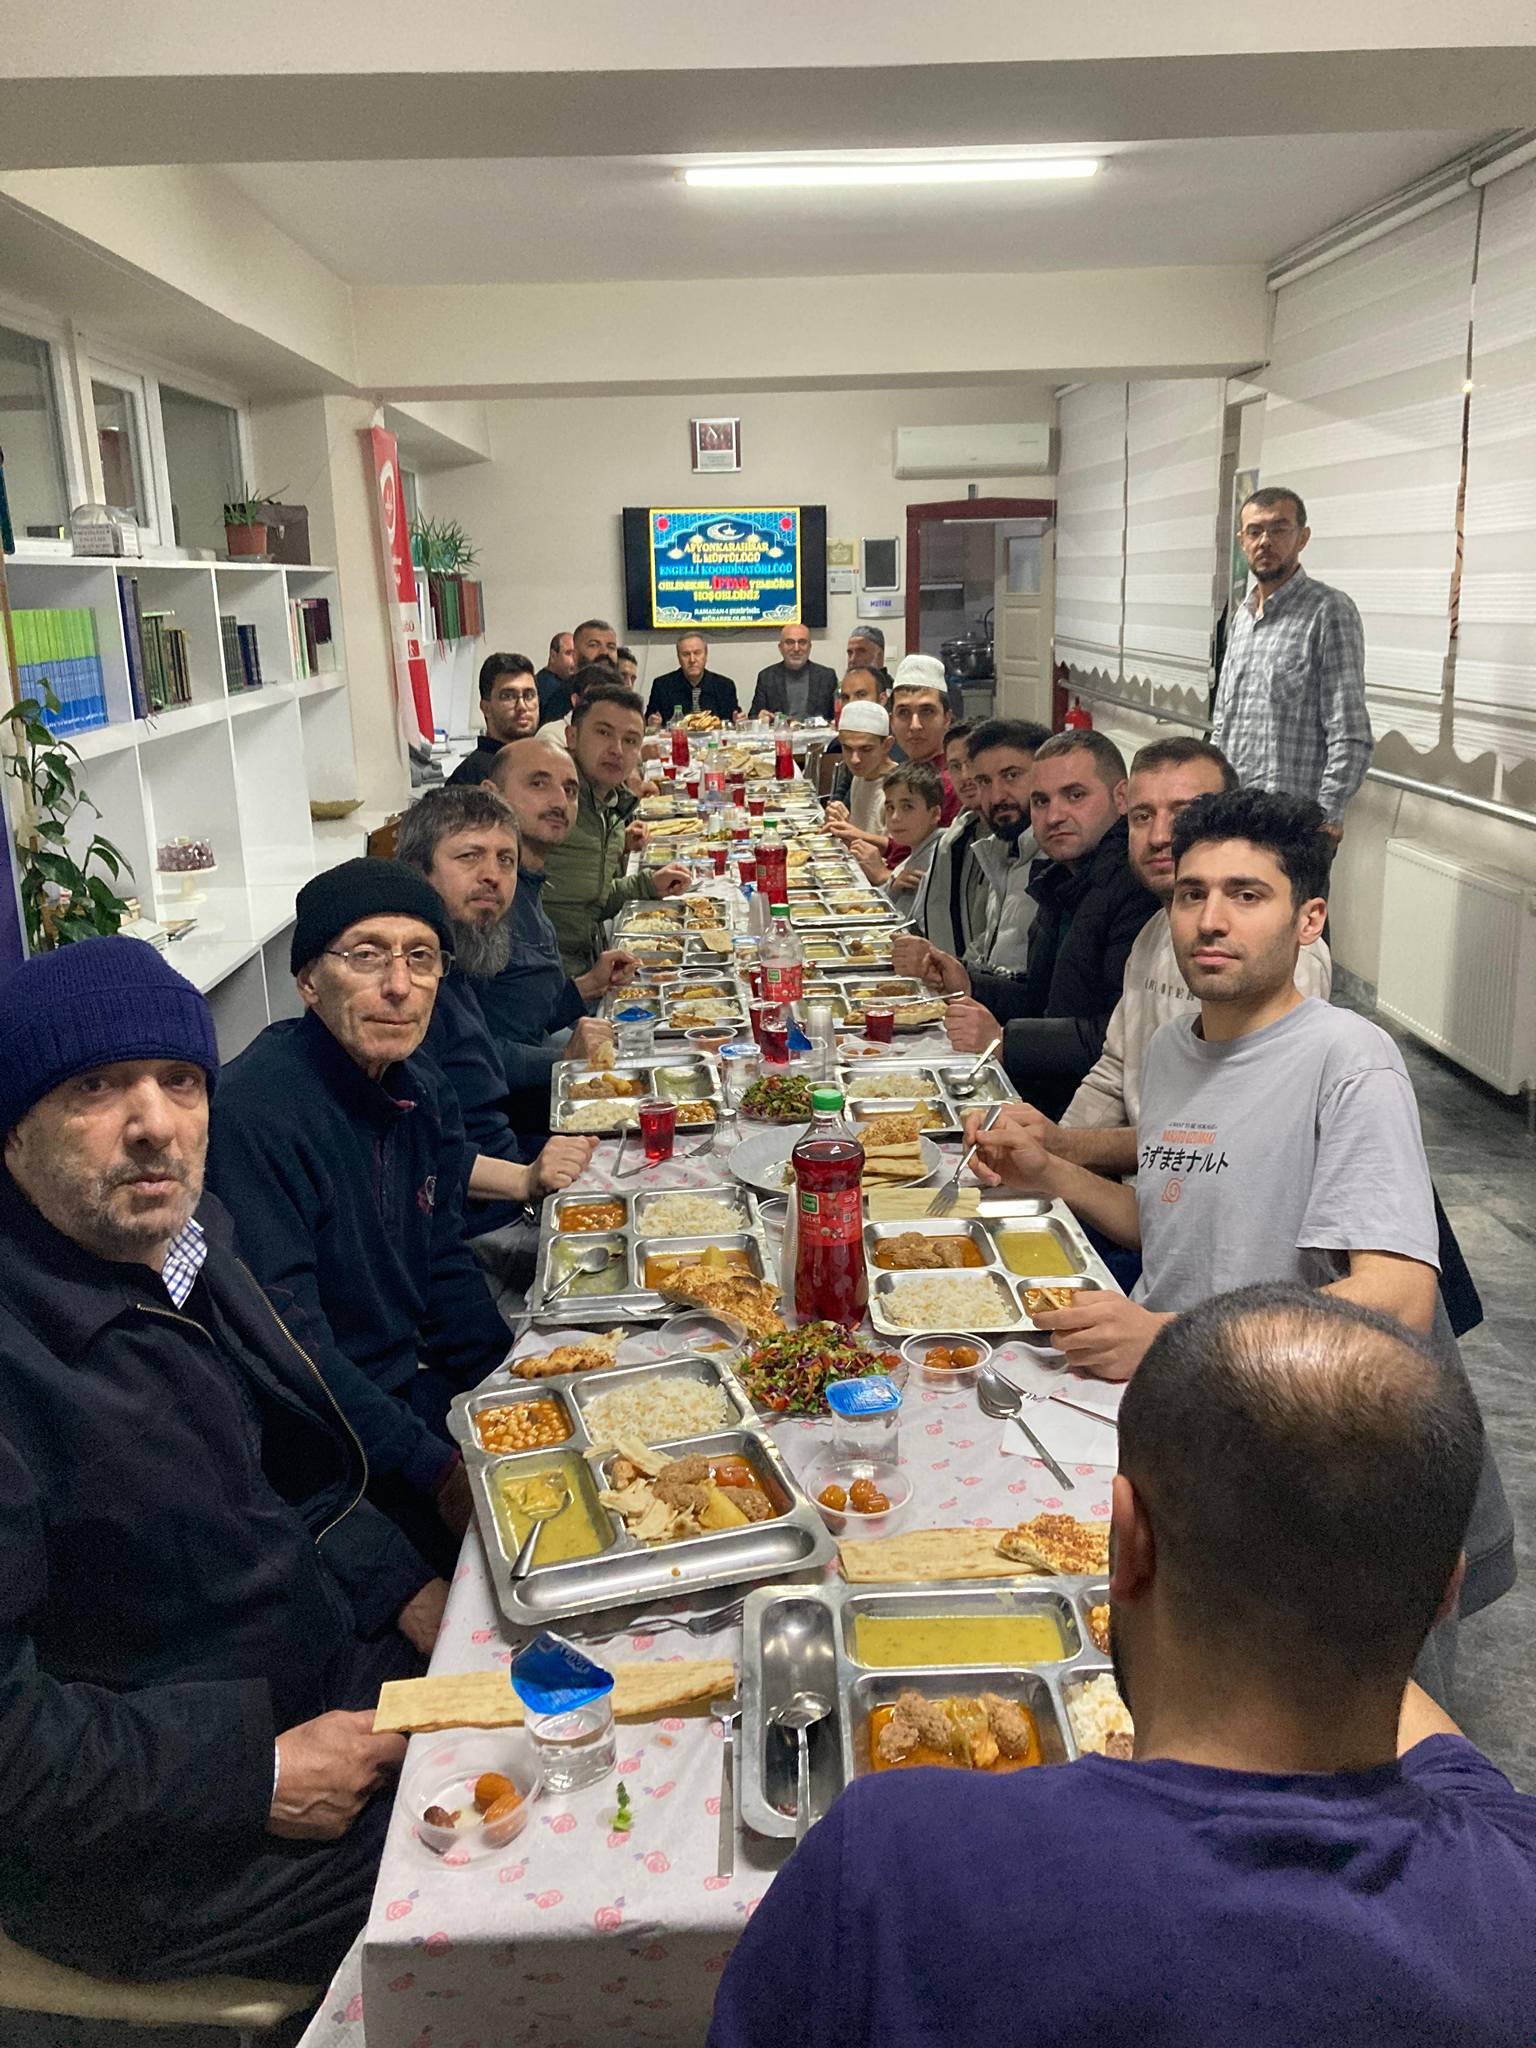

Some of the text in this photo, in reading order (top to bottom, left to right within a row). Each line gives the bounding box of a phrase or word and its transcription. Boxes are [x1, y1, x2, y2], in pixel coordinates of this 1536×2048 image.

[659, 564, 699, 576] ENGELLİ
[1140, 1145, 1229, 1174] うずまきナルト
